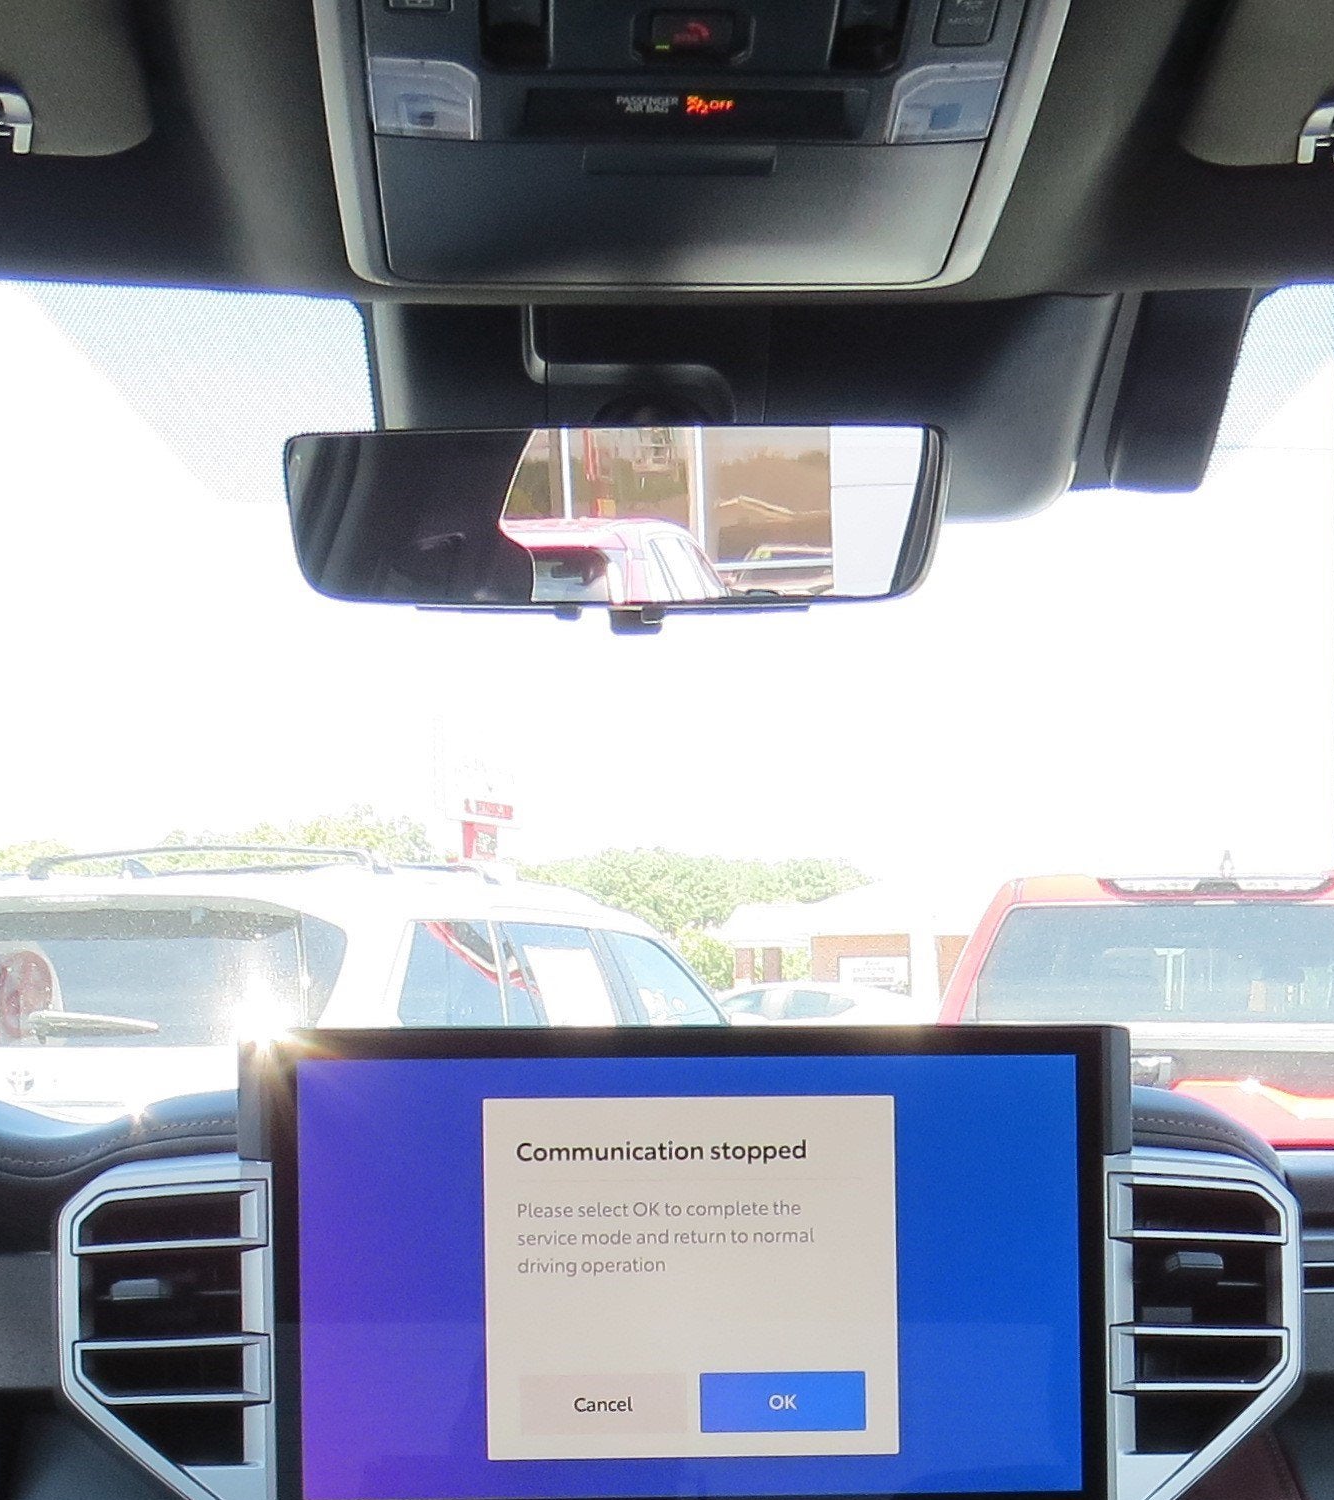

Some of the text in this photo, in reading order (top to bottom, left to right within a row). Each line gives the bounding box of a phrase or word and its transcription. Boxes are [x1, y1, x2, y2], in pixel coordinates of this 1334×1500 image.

[616, 95, 679, 106] PASSENGER
[624, 104, 669, 114] AIR BAG
[710, 100, 734, 110] OFF
[516, 1139, 807, 1165] Communication stopped
[517, 1200, 801, 1222] Please select OK to complete the
[517, 1228, 815, 1246] service mode and return to normal
[517, 1258, 666, 1278] driving operation
[573, 1396, 634, 1413] Cancel
[768, 1395, 798, 1411] OK
